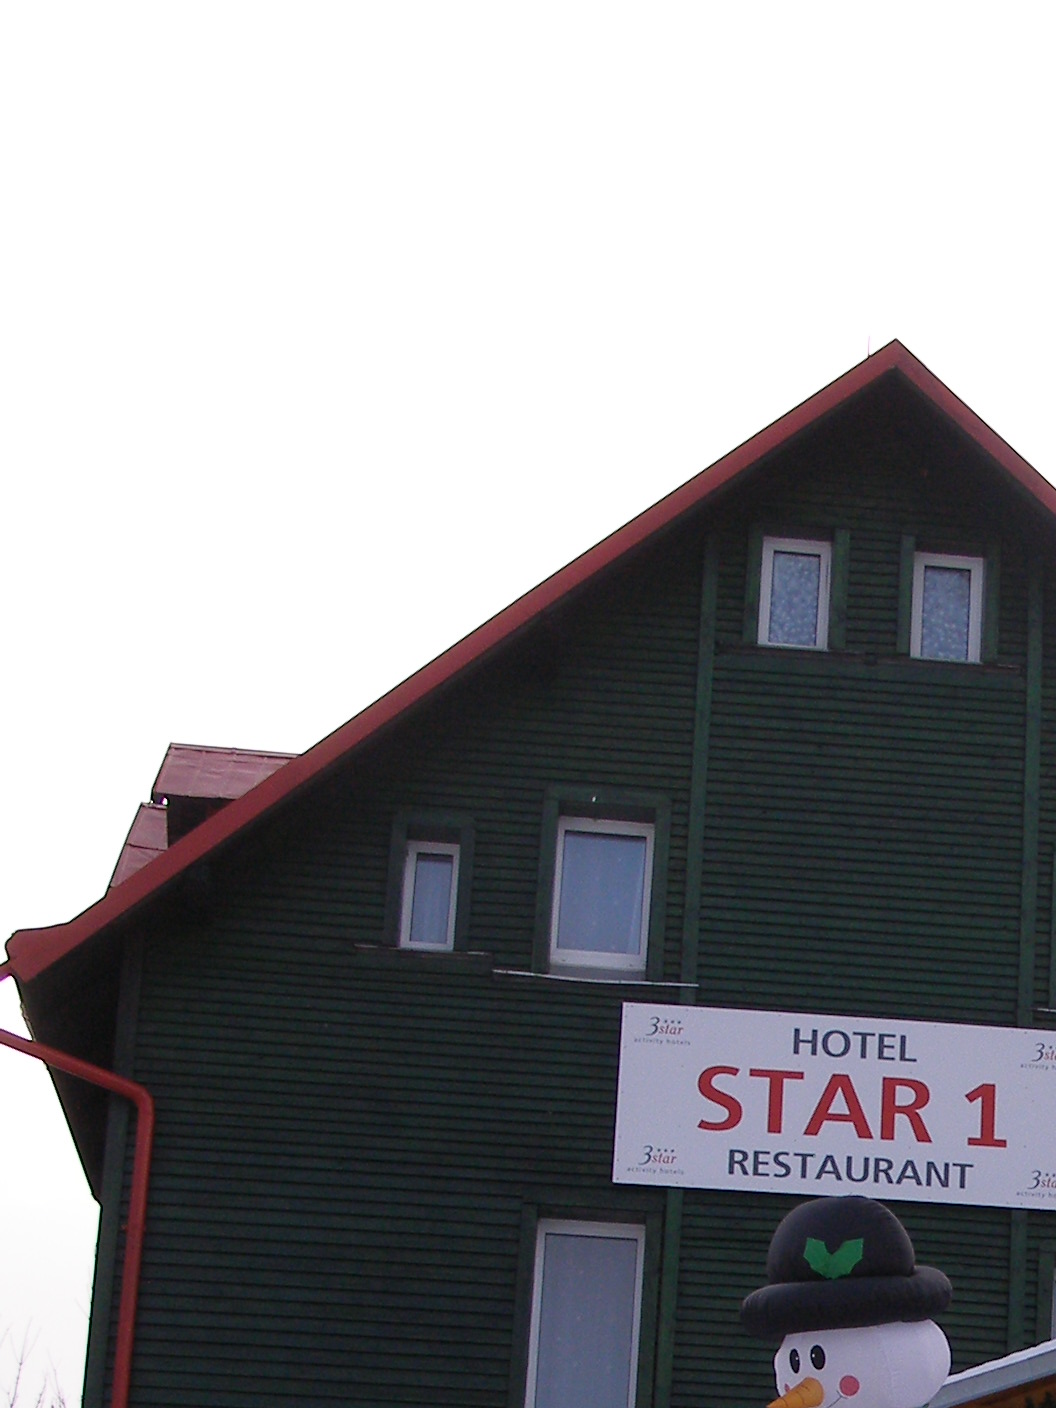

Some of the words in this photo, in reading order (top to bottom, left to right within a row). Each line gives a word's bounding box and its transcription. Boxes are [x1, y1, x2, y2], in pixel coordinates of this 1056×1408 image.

[792, 1027, 918, 1063] HOTEL
[697, 1065, 933, 1144] STAR
[965, 1083, 1007, 1148] 1
[727, 1149, 974, 1189] RESTAURANT
